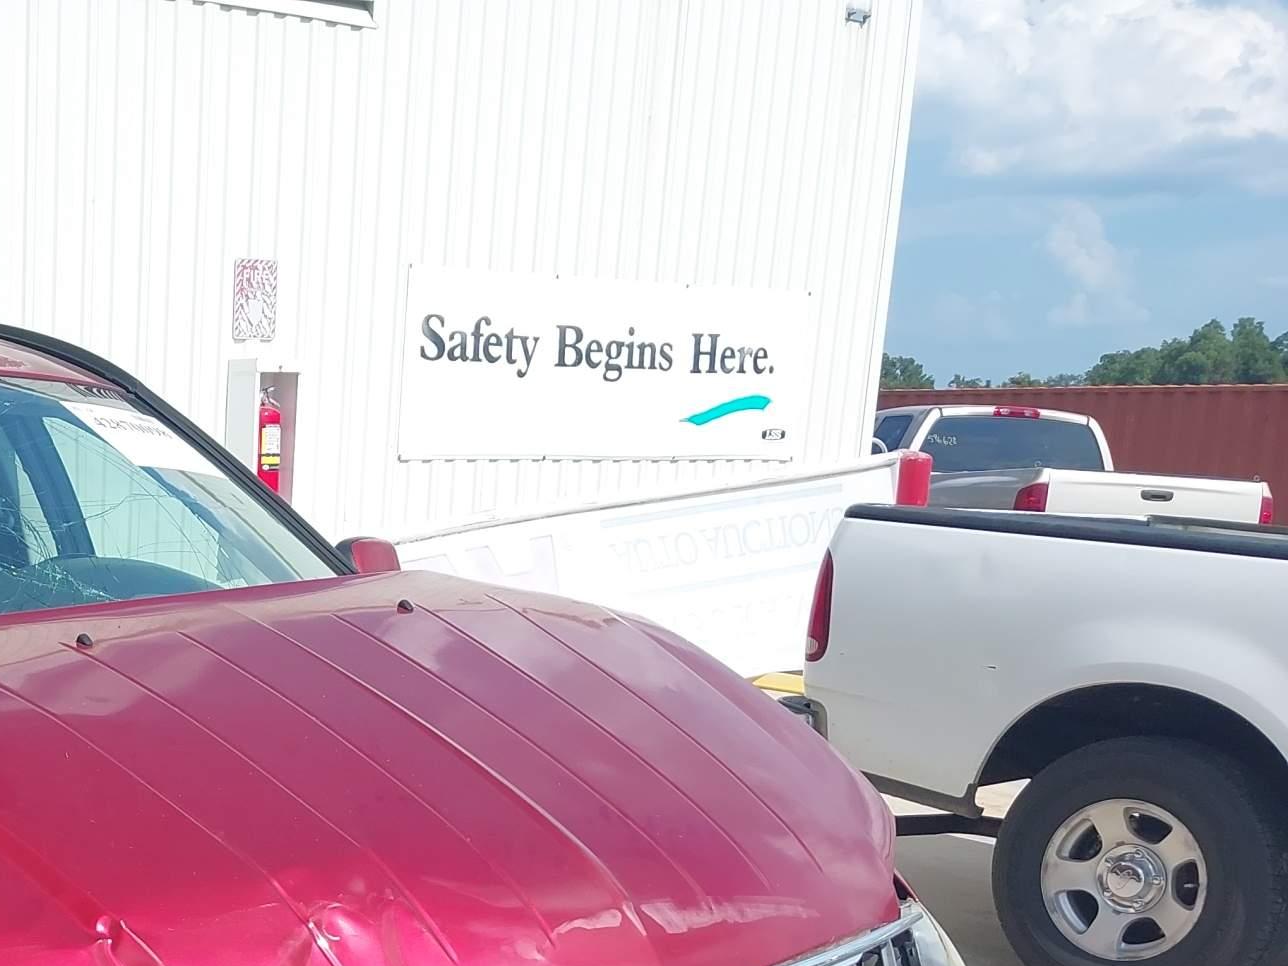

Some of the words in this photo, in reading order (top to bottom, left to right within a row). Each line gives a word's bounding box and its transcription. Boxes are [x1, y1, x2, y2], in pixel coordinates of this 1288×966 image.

[242, 269, 274, 289] FIRE
[419, 313, 540, 378] Safety
[553, 324, 674, 383] Begins
[688, 332, 775, 375] Here.
